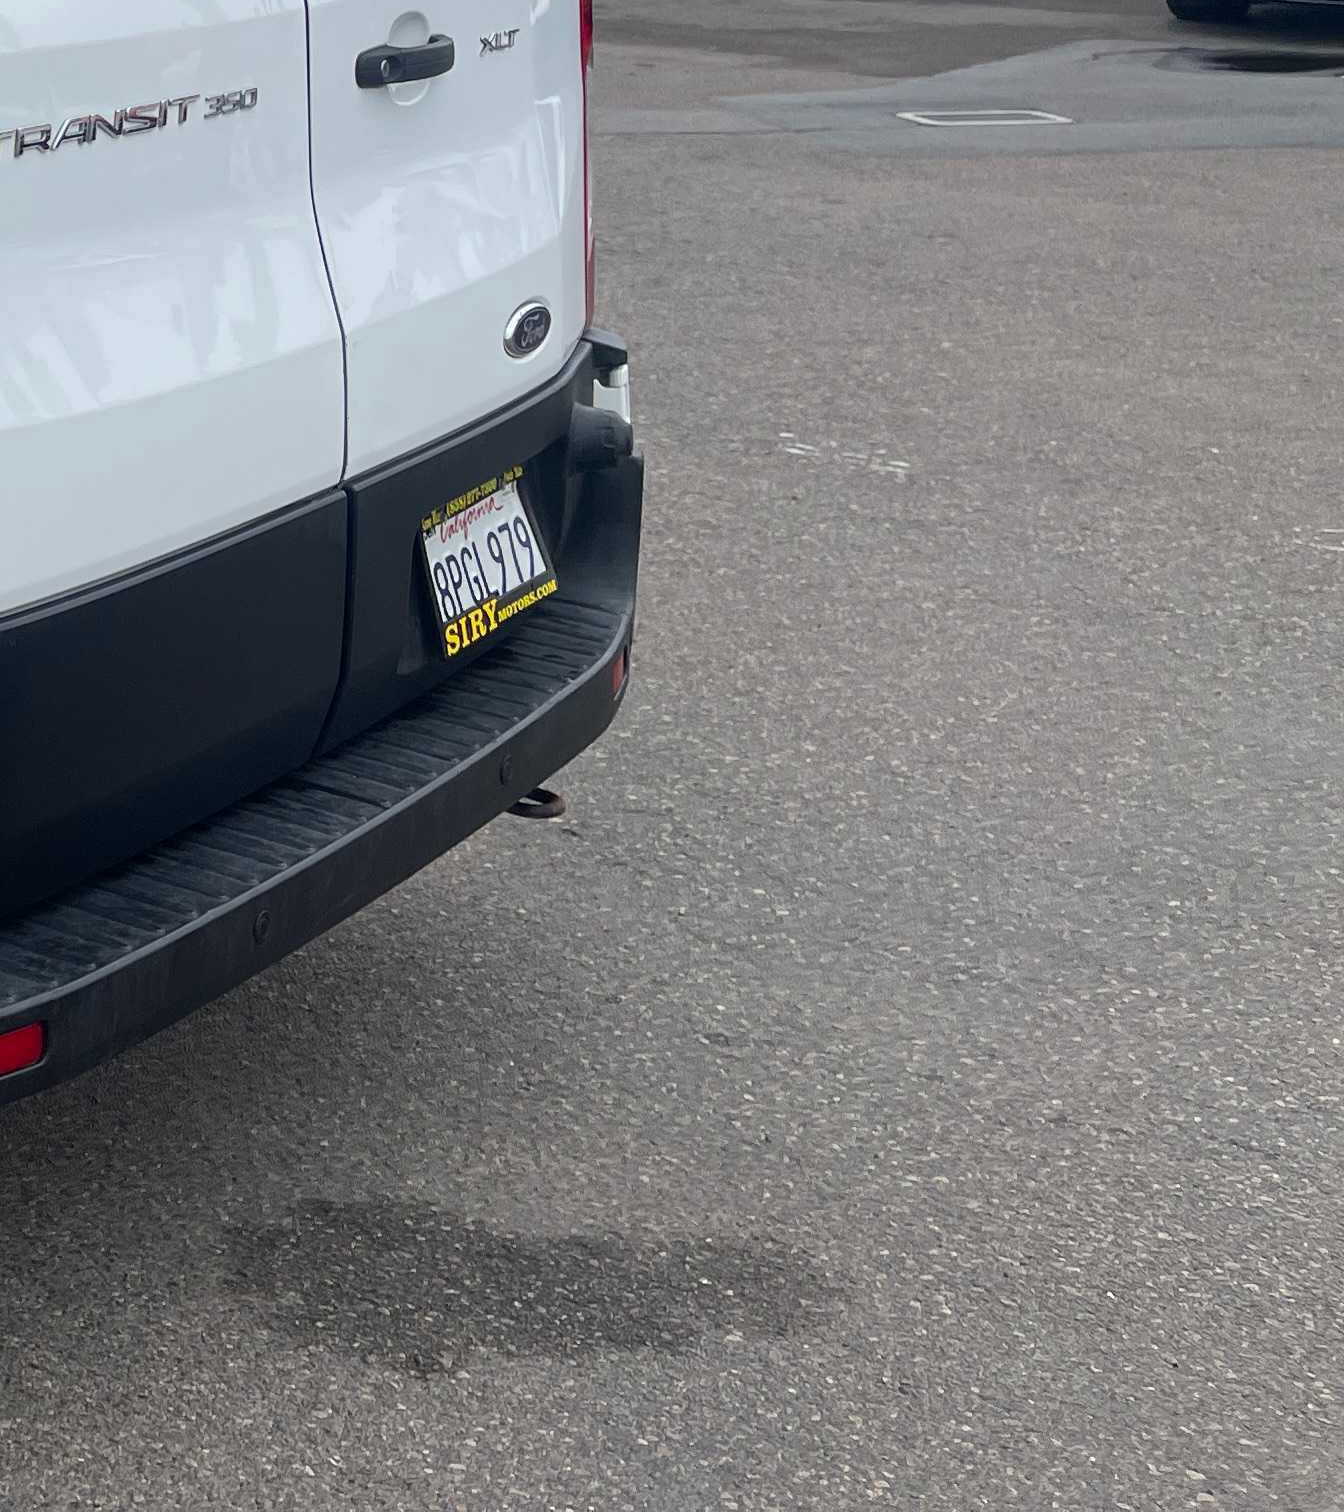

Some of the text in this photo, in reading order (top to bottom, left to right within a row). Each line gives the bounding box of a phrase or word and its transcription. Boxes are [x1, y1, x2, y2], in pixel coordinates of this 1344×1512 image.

[479, 28, 520, 57] XLT
[203, 87, 258, 119] 350
[439, 495, 504, 544] California
[432, 515, 536, 623] 8PGL979
